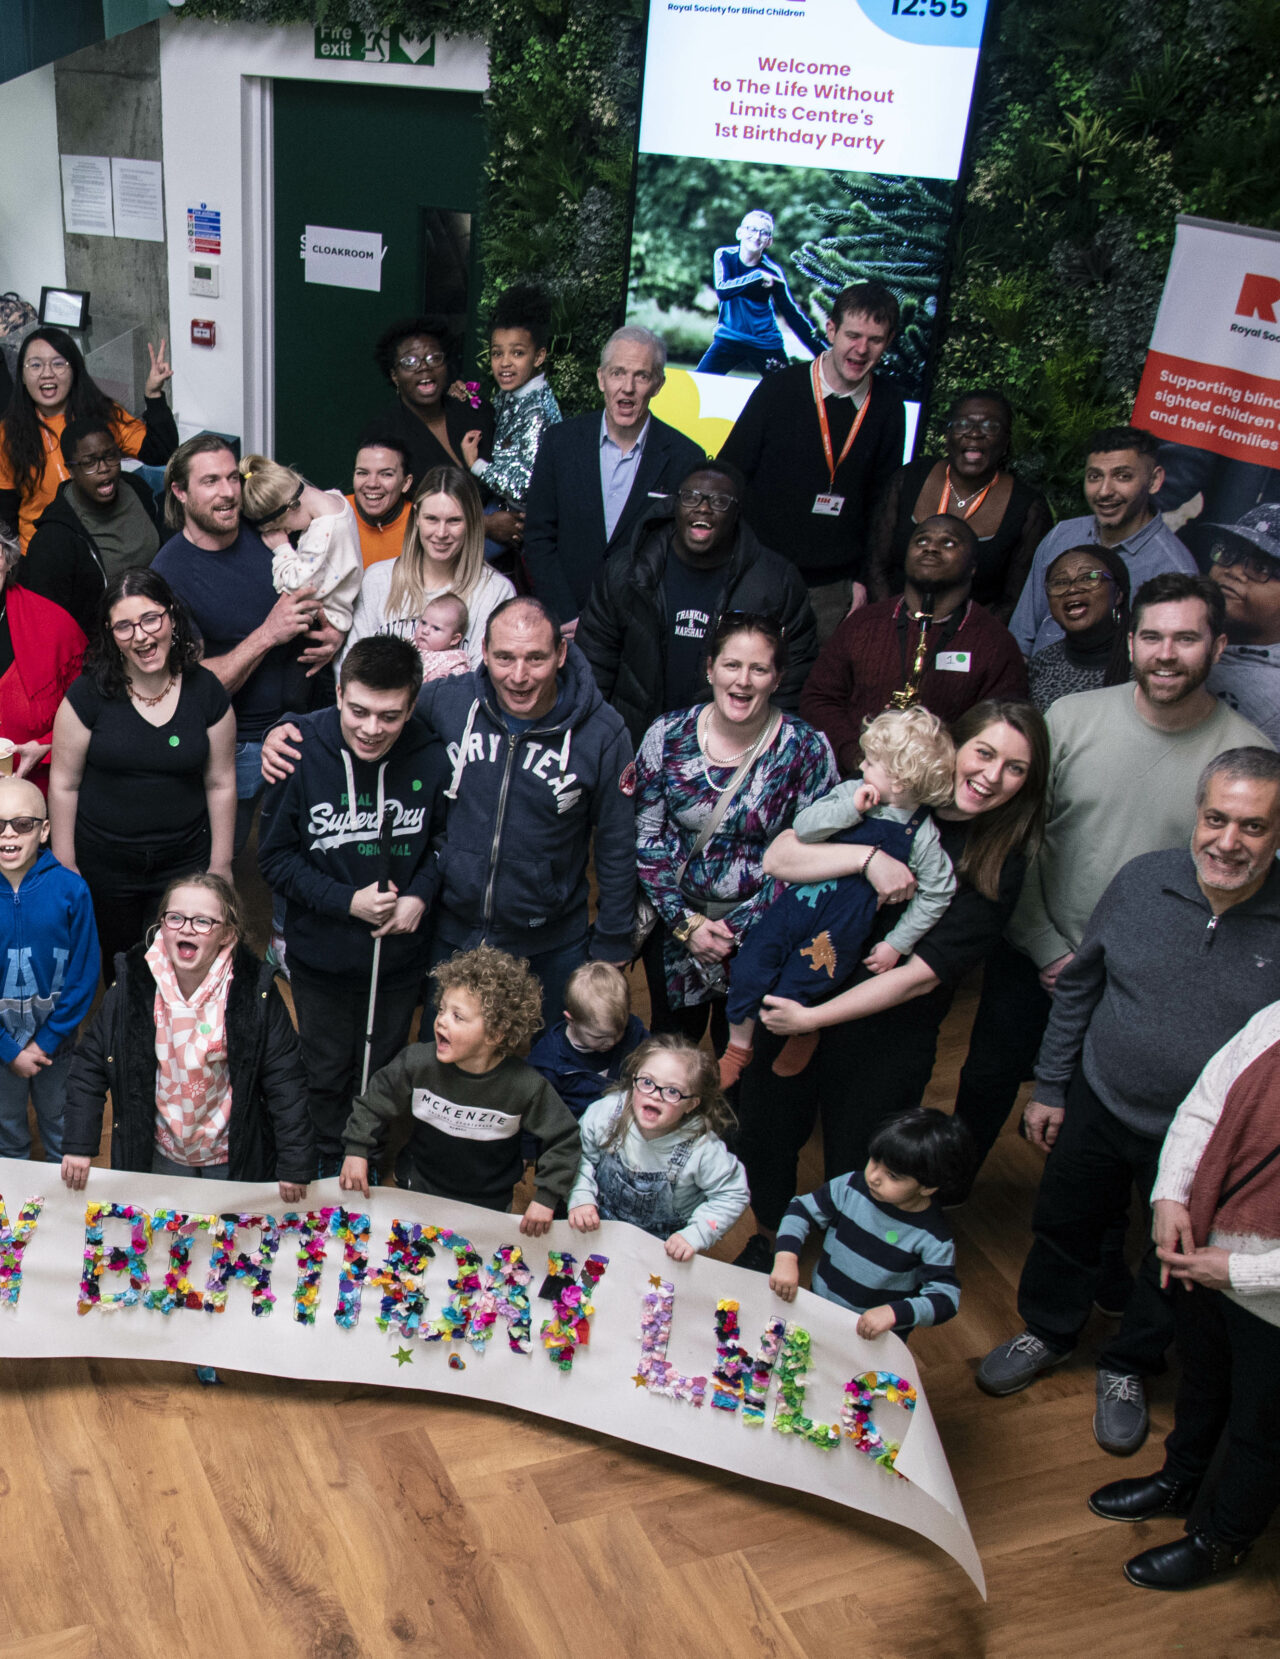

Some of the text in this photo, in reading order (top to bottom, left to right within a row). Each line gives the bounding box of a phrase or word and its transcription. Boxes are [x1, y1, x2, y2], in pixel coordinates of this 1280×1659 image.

[668, 3, 805, 17] Royal Society for Blind Children
[321, 41, 351, 57] exit
[758, 56, 851, 77] Welcome
[712, 77, 895, 103] to The Life Without
[730, 101, 874, 126] Limits Centre's
[714, 122, 885, 155] 1st Birthday Party
[312, 245, 374, 260] CLOAKROOM
[1230, 323, 1262, 339] Royal
[1160, 369, 1241, 403] Supporting
[1155, 389, 1275, 430] sighted children
[1150, 408, 1178, 426] and
[1181, 415, 1217, 434] their
[1218, 424, 1279, 451] families
[340, 793, 373, 806] RAL
[422, 1094, 508, 1125] MCKENZIE
[77, 1200, 610, 1371] BIRTHDAY
[632, 1274, 917, 1481] LWLC
